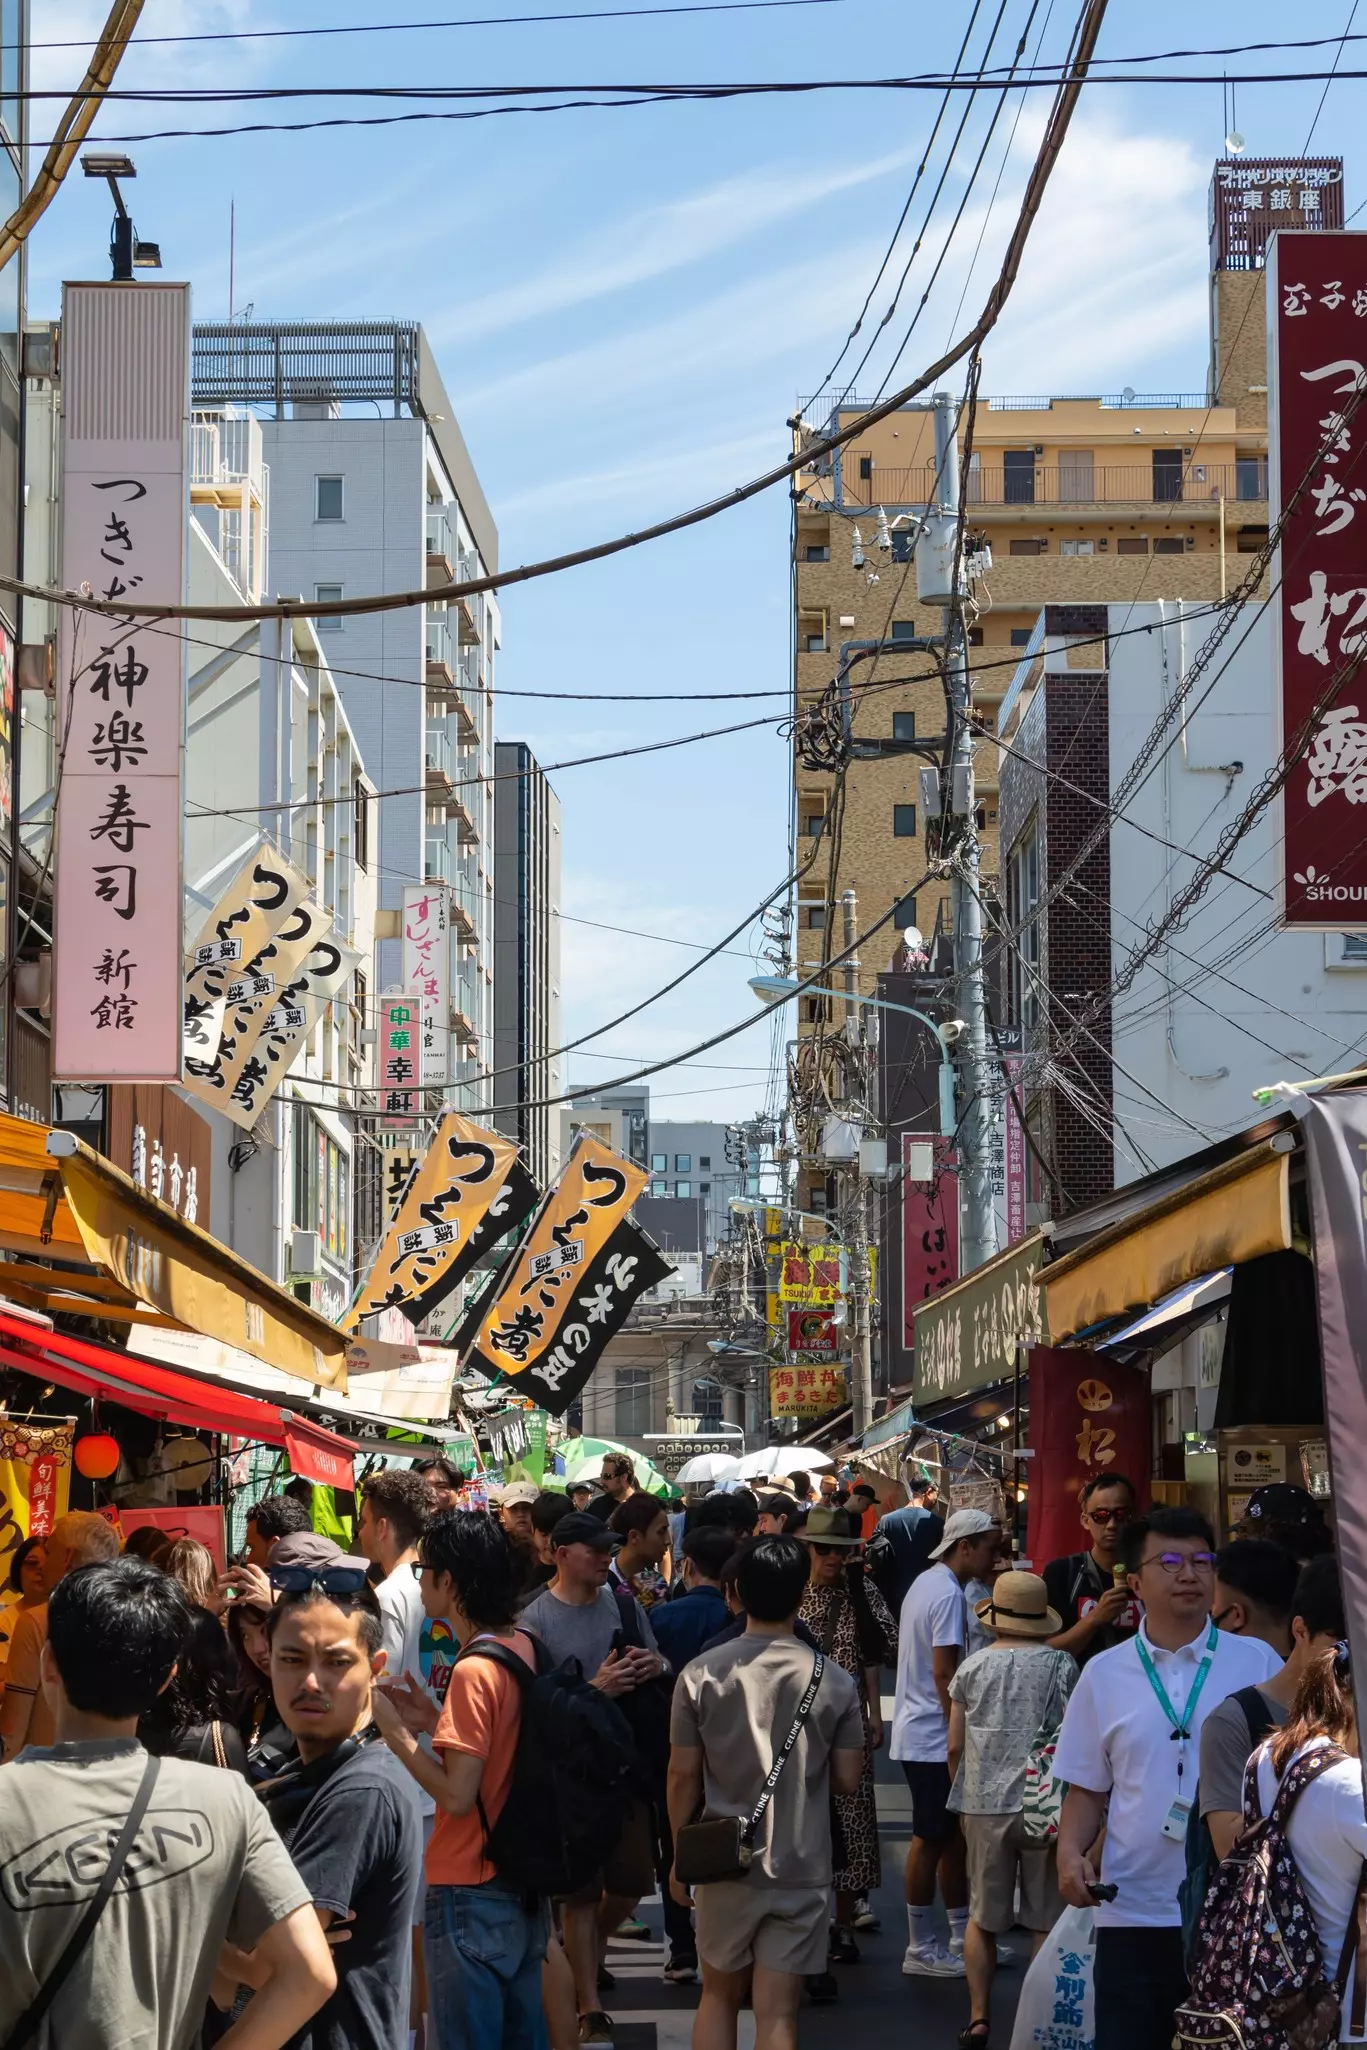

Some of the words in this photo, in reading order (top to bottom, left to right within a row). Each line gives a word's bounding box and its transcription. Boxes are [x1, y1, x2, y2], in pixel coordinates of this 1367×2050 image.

[1217, 166, 1344, 187] ライオンズマンション
[1242, 189, 1321, 211] 東銀座
[89, 479, 151, 921] つきぢ神楽寿司
[1306, 886, 1367, 901] SHOU
[90, 948, 140, 1030] 新館
[406, 895, 441, 1010] すしざんまい
[386, 1005, 414, 1113] 中華幸軒
[491, 1161, 627, 1362] つくだ煮
[776, 1369, 838, 1388] 海鮮丼
[777, 1390, 838, 1404] まるきた
[778, 1404, 818, 1412] MARUKITA
[31, 1463, 53, 1537] 旬鮮美味
[752, 1792, 769, 1824] CELINE
[767, 1756, 785, 1787] CELINE
[784, 1719, 802, 1750] CELINE
[800, 1683, 817, 1714] CELINE
[815, 1653, 824, 1678] CELIN
